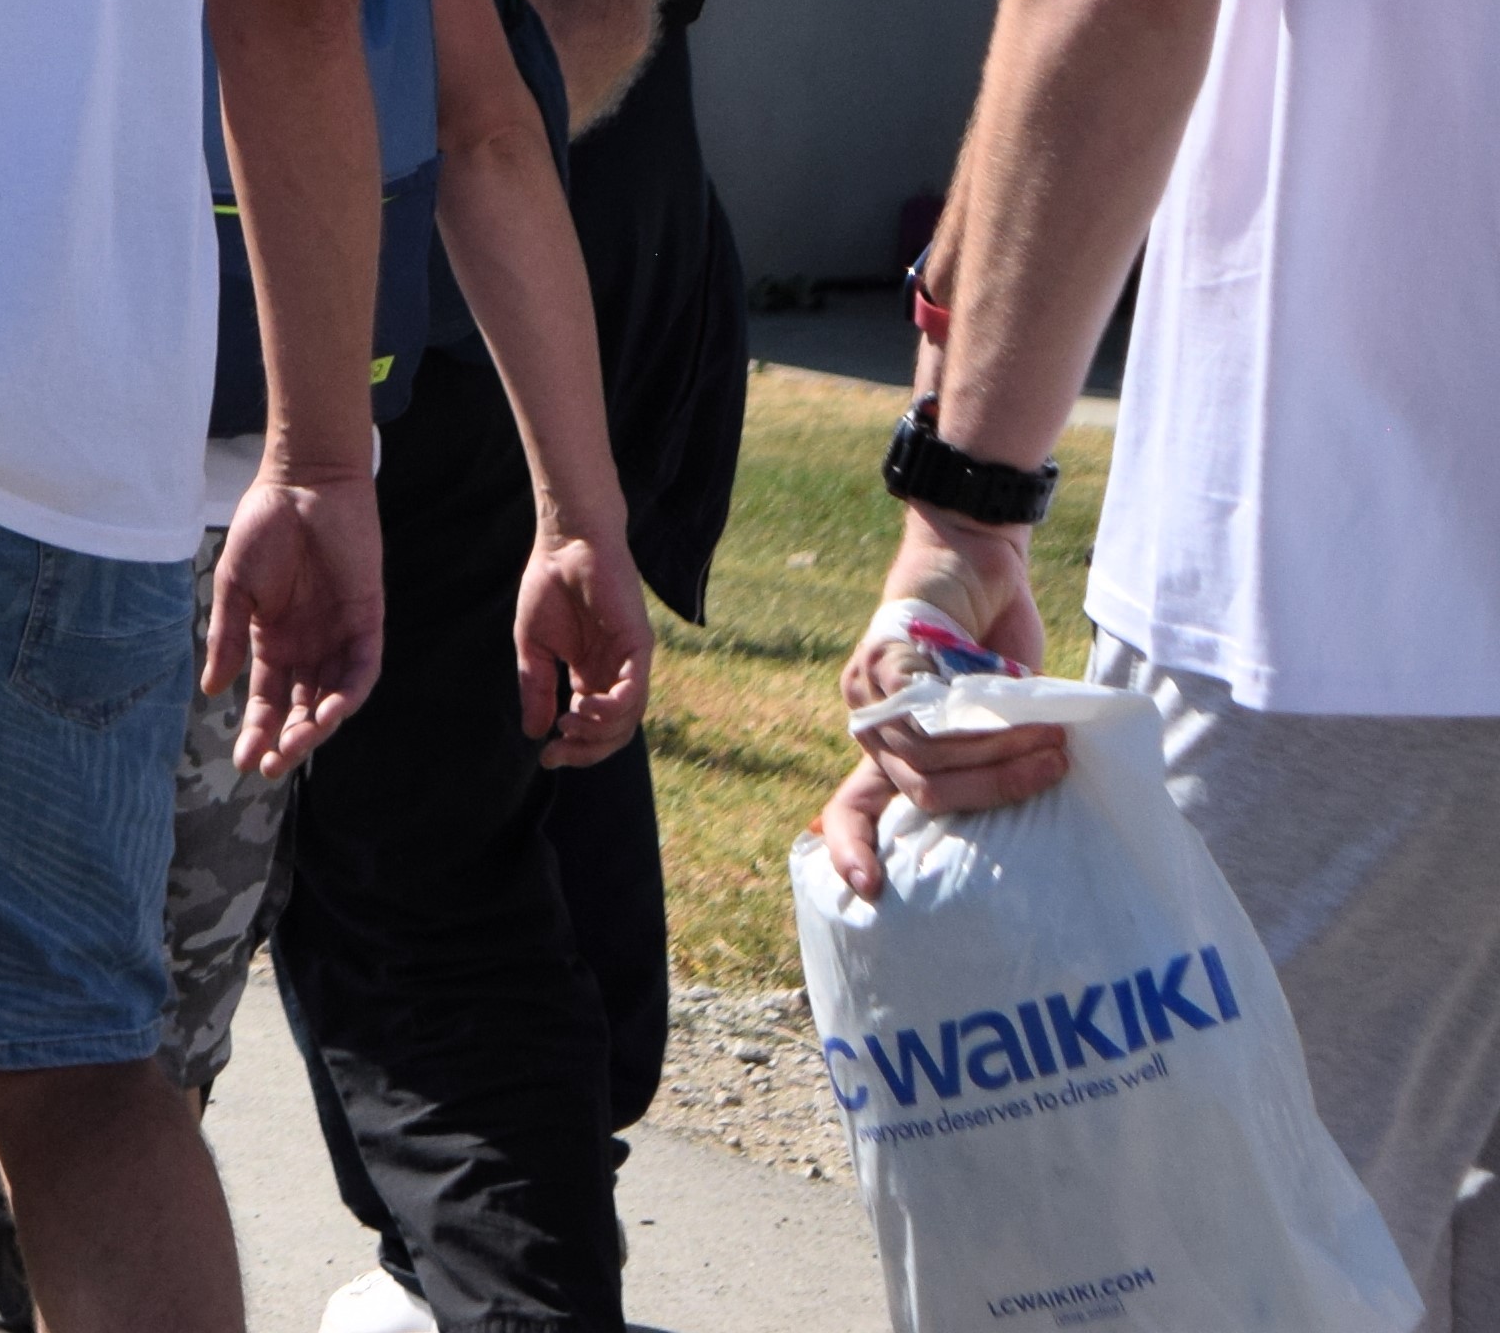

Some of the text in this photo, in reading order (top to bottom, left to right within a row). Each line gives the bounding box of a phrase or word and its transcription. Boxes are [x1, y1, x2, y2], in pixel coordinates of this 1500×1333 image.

[937, 1095, 1032, 1135] deserves
[1034, 1091, 1059, 1112] to
[1061, 1080, 1119, 1109] dress
[1119, 1052, 1170, 1090] well
